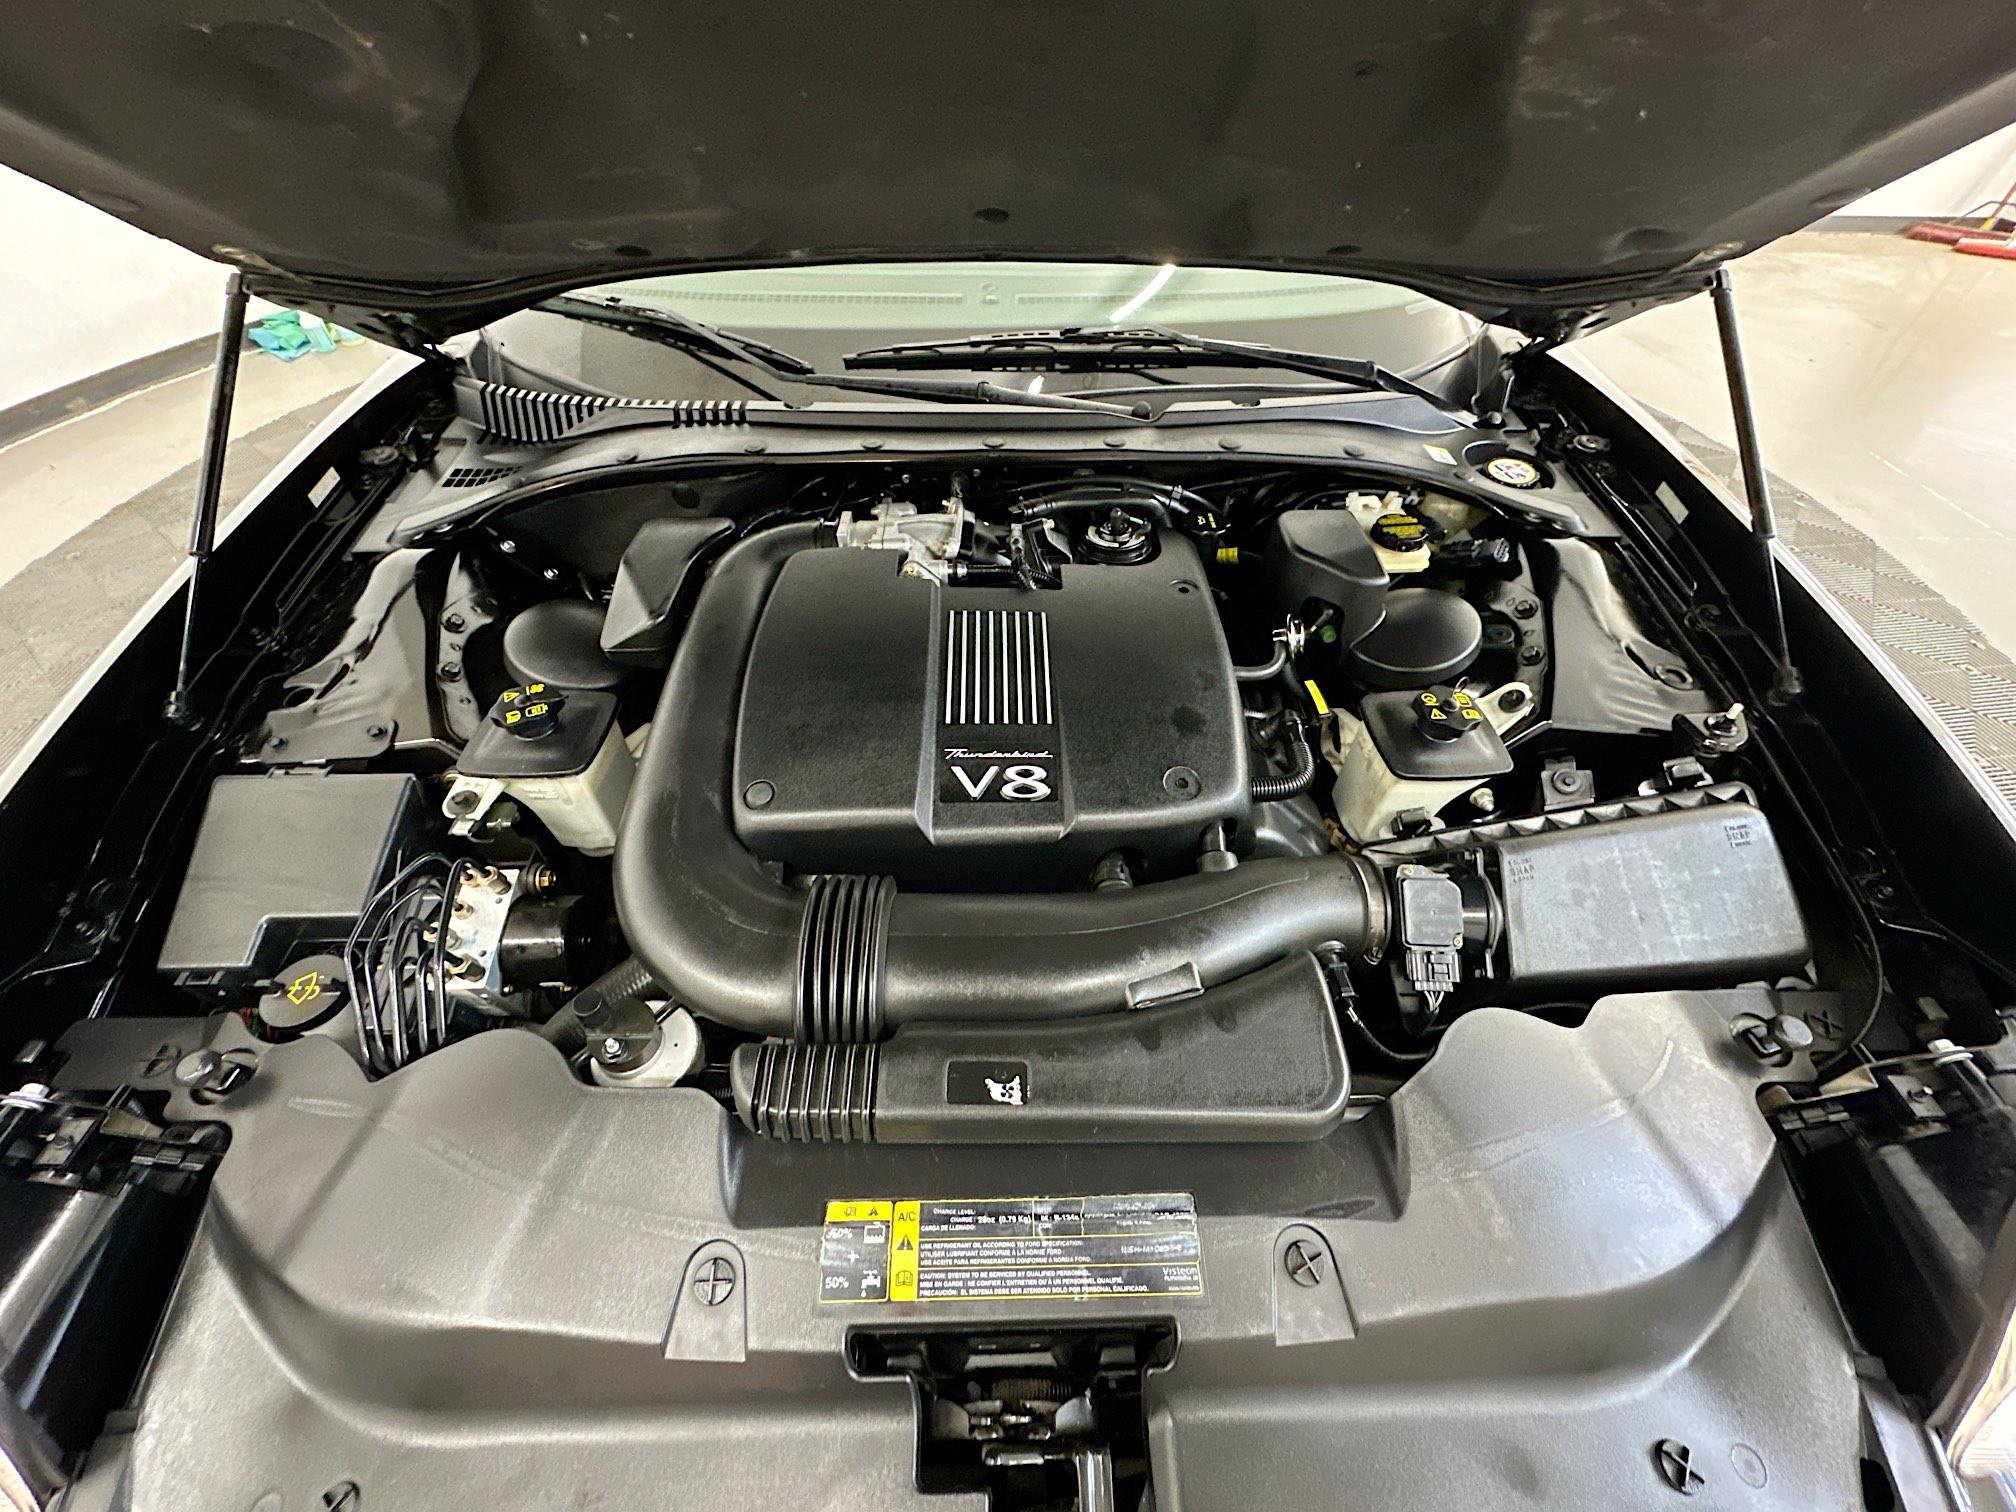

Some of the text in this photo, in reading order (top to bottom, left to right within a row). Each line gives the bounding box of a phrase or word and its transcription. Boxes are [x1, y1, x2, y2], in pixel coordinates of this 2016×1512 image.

[944, 748, 1054, 760] Thunderbird
[950, 765, 1052, 802] V8
[898, 1211, 916, 1222] A/C
[825, 1276, 849, 1289] 50%
